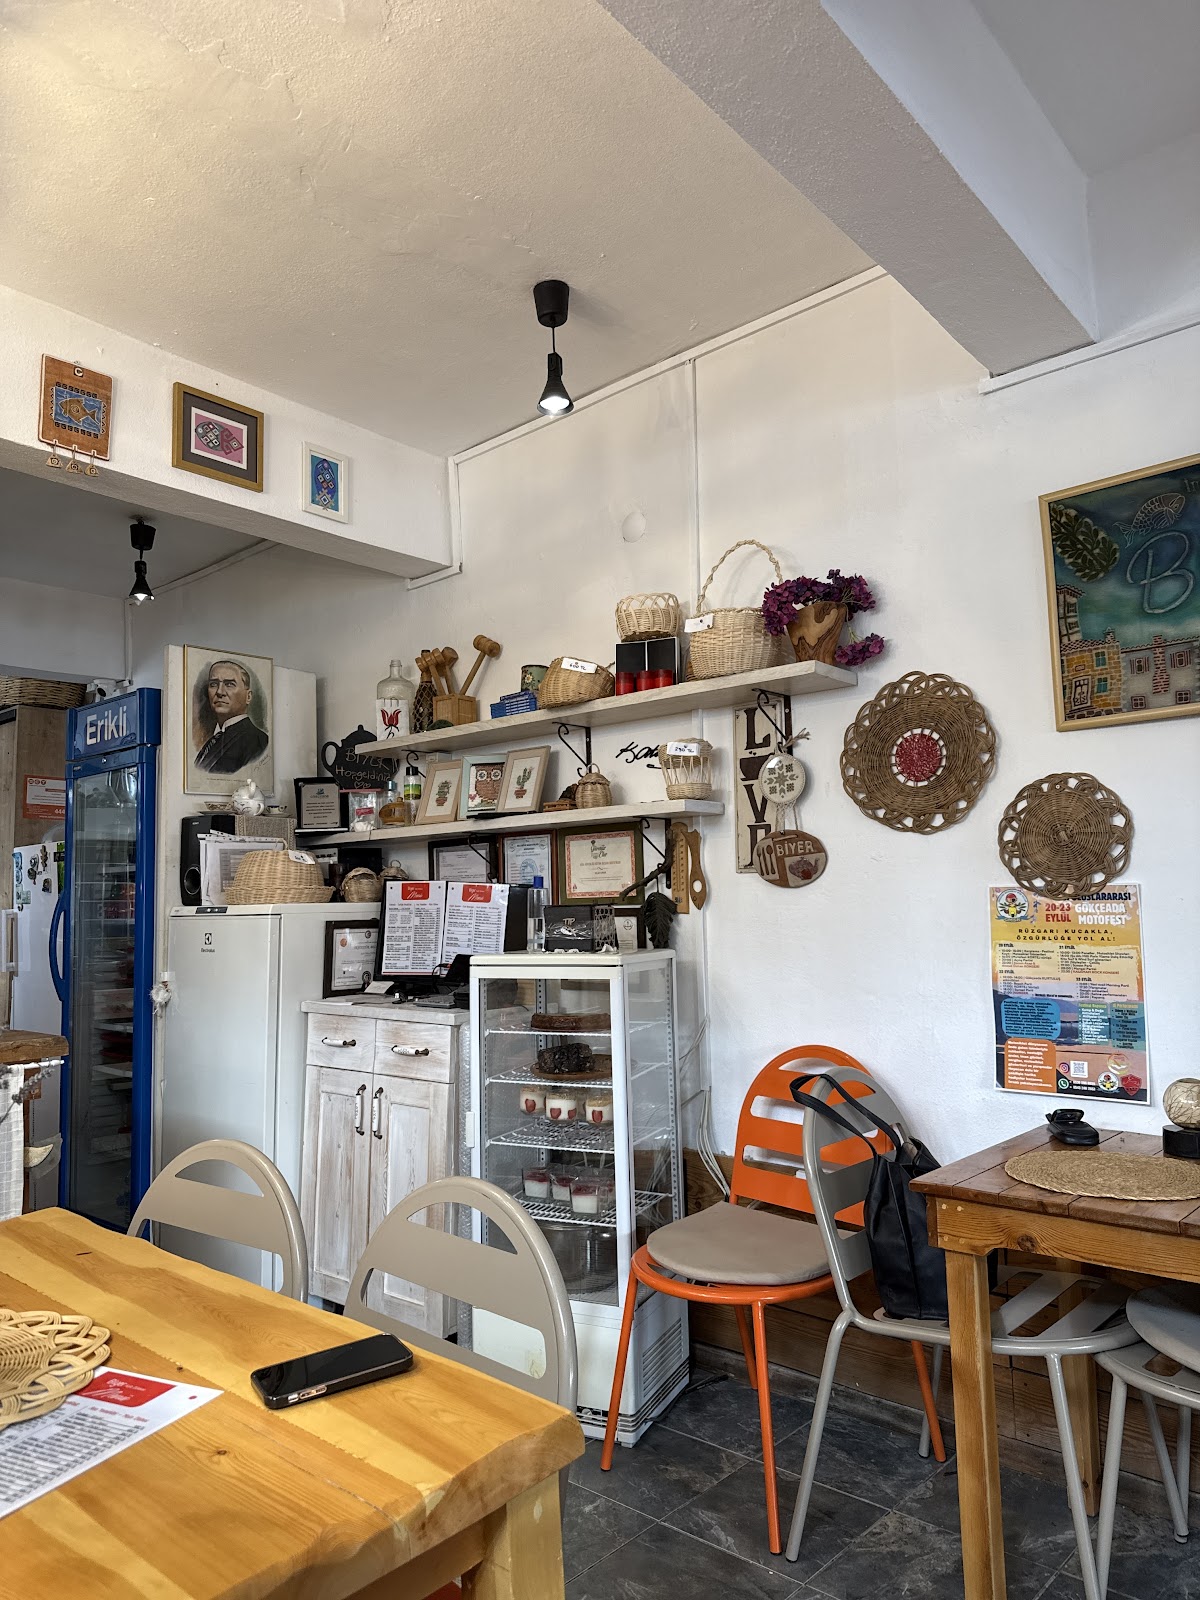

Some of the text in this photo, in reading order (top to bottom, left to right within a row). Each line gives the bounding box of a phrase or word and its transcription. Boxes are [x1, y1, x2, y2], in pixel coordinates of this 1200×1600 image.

[86, 705, 127, 745] Erikli
[775, 840, 815, 857] BİYER
[1045, 901, 1126, 914] 20-23 GÖKÇEADA
[562, 918, 575, 926] TIP
[1045, 912, 1127, 925] EYLÜL MOTOFEST
